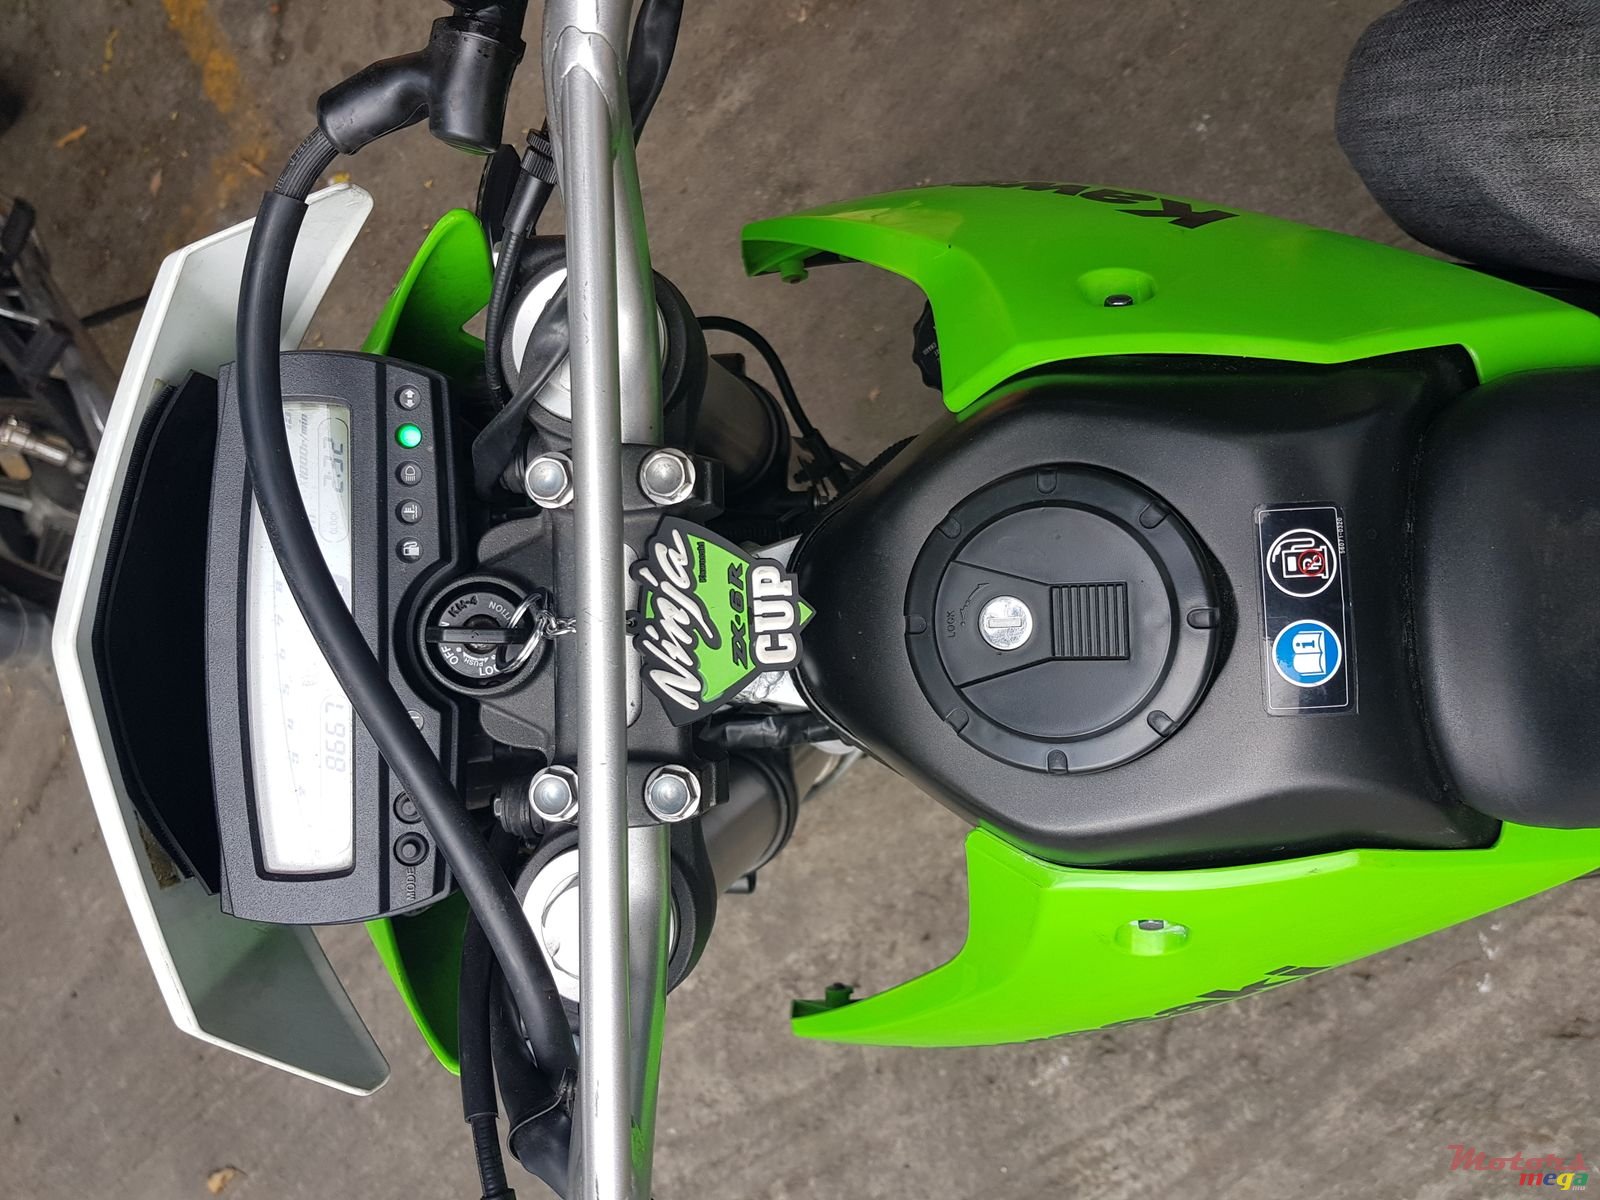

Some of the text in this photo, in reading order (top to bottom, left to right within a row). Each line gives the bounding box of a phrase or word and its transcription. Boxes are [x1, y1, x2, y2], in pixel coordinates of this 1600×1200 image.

[322, 436, 344, 494] 2:32
[639, 529, 713, 710] Ninja
[752, 566, 797, 664] CUP
[947, 610, 955, 637] LOCK
[441, 646, 459, 664] OFF
[464, 657, 483, 666] PUSH
[325, 702, 346, 772] 8667
[406, 867, 416, 900] MODE
